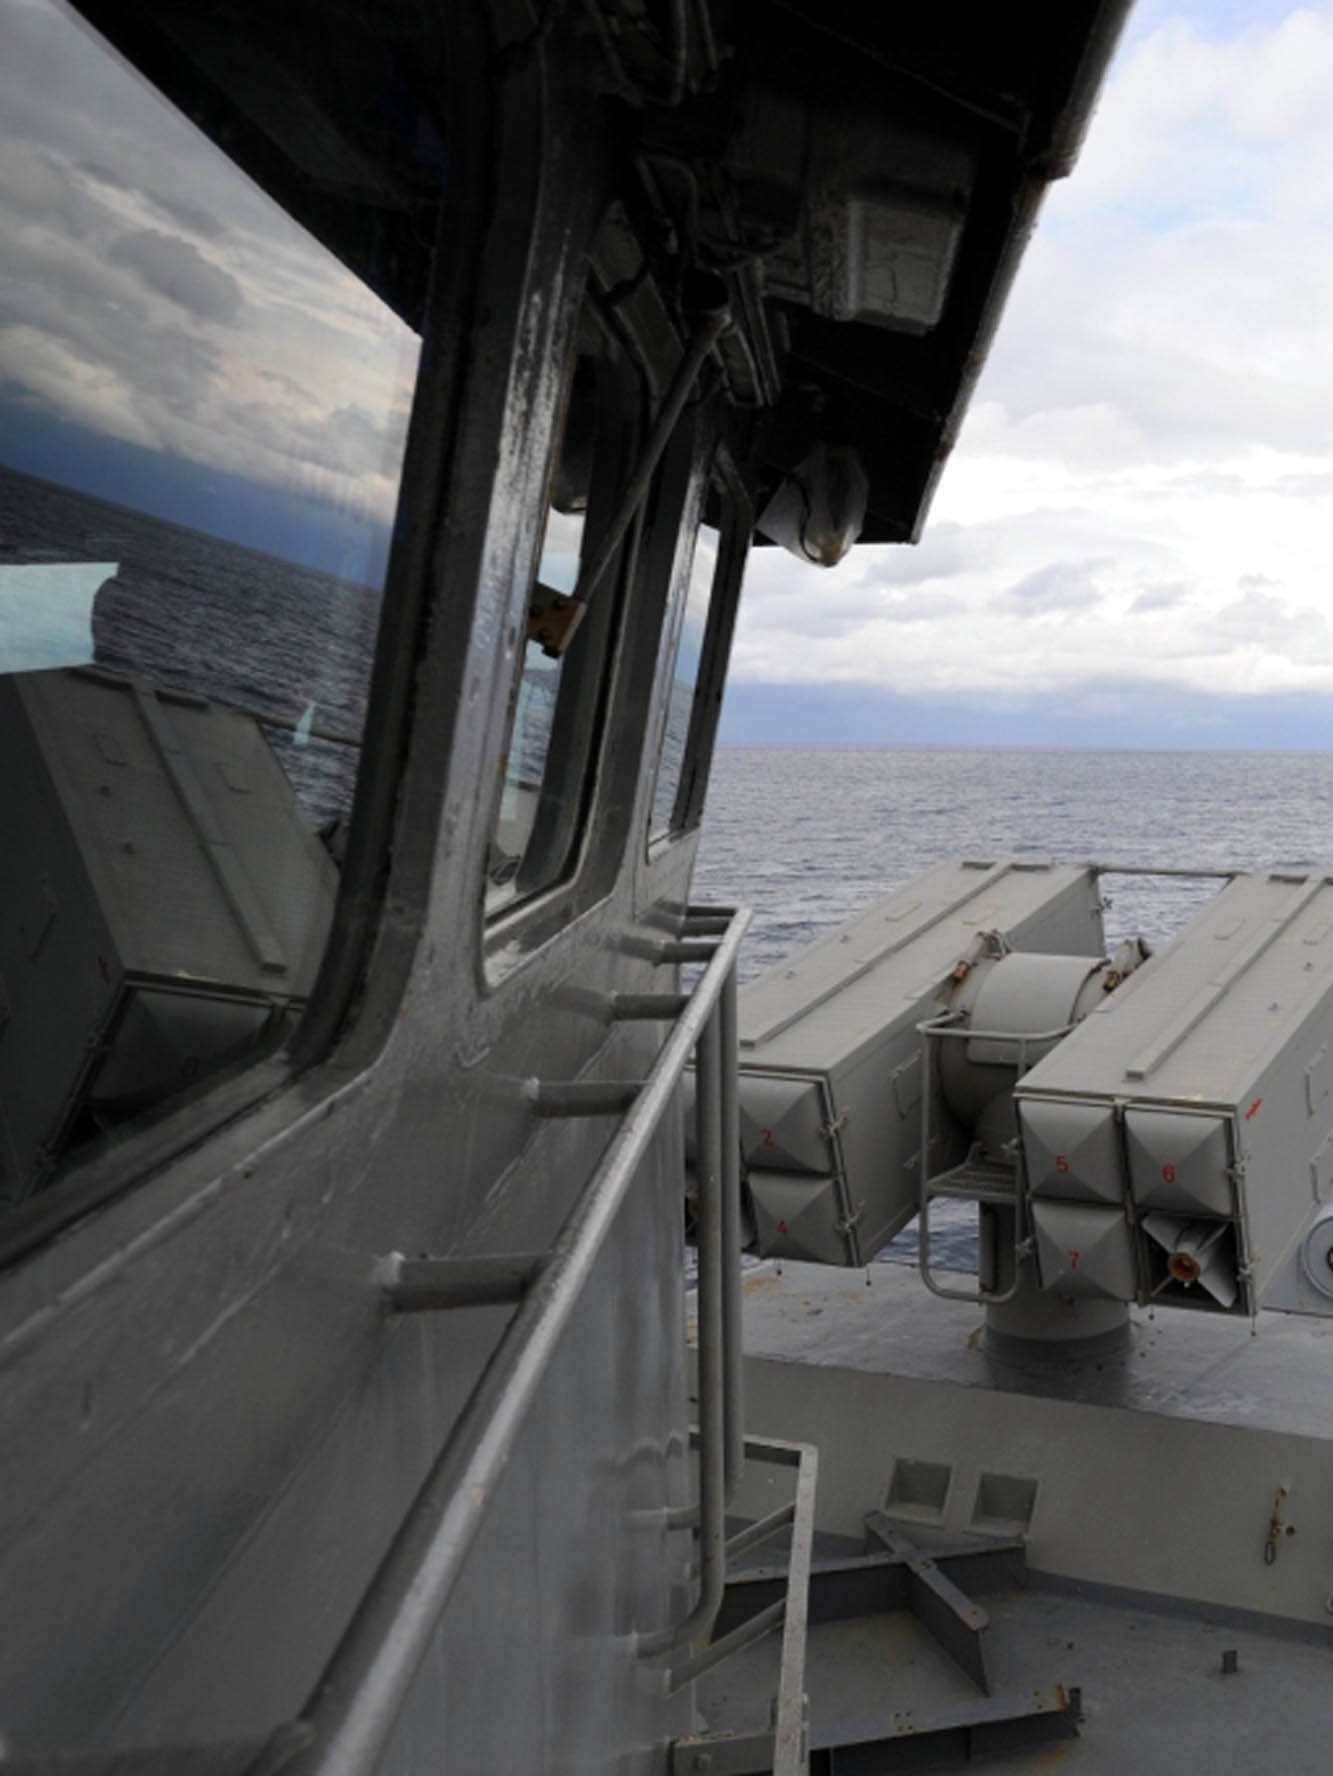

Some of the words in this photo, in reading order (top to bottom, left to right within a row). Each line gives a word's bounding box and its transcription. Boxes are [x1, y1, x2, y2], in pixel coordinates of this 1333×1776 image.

[1055, 1154, 1070, 1174] 5
[1161, 1162, 1176, 1183] 6
[1067, 1249, 1080, 1270] 7
